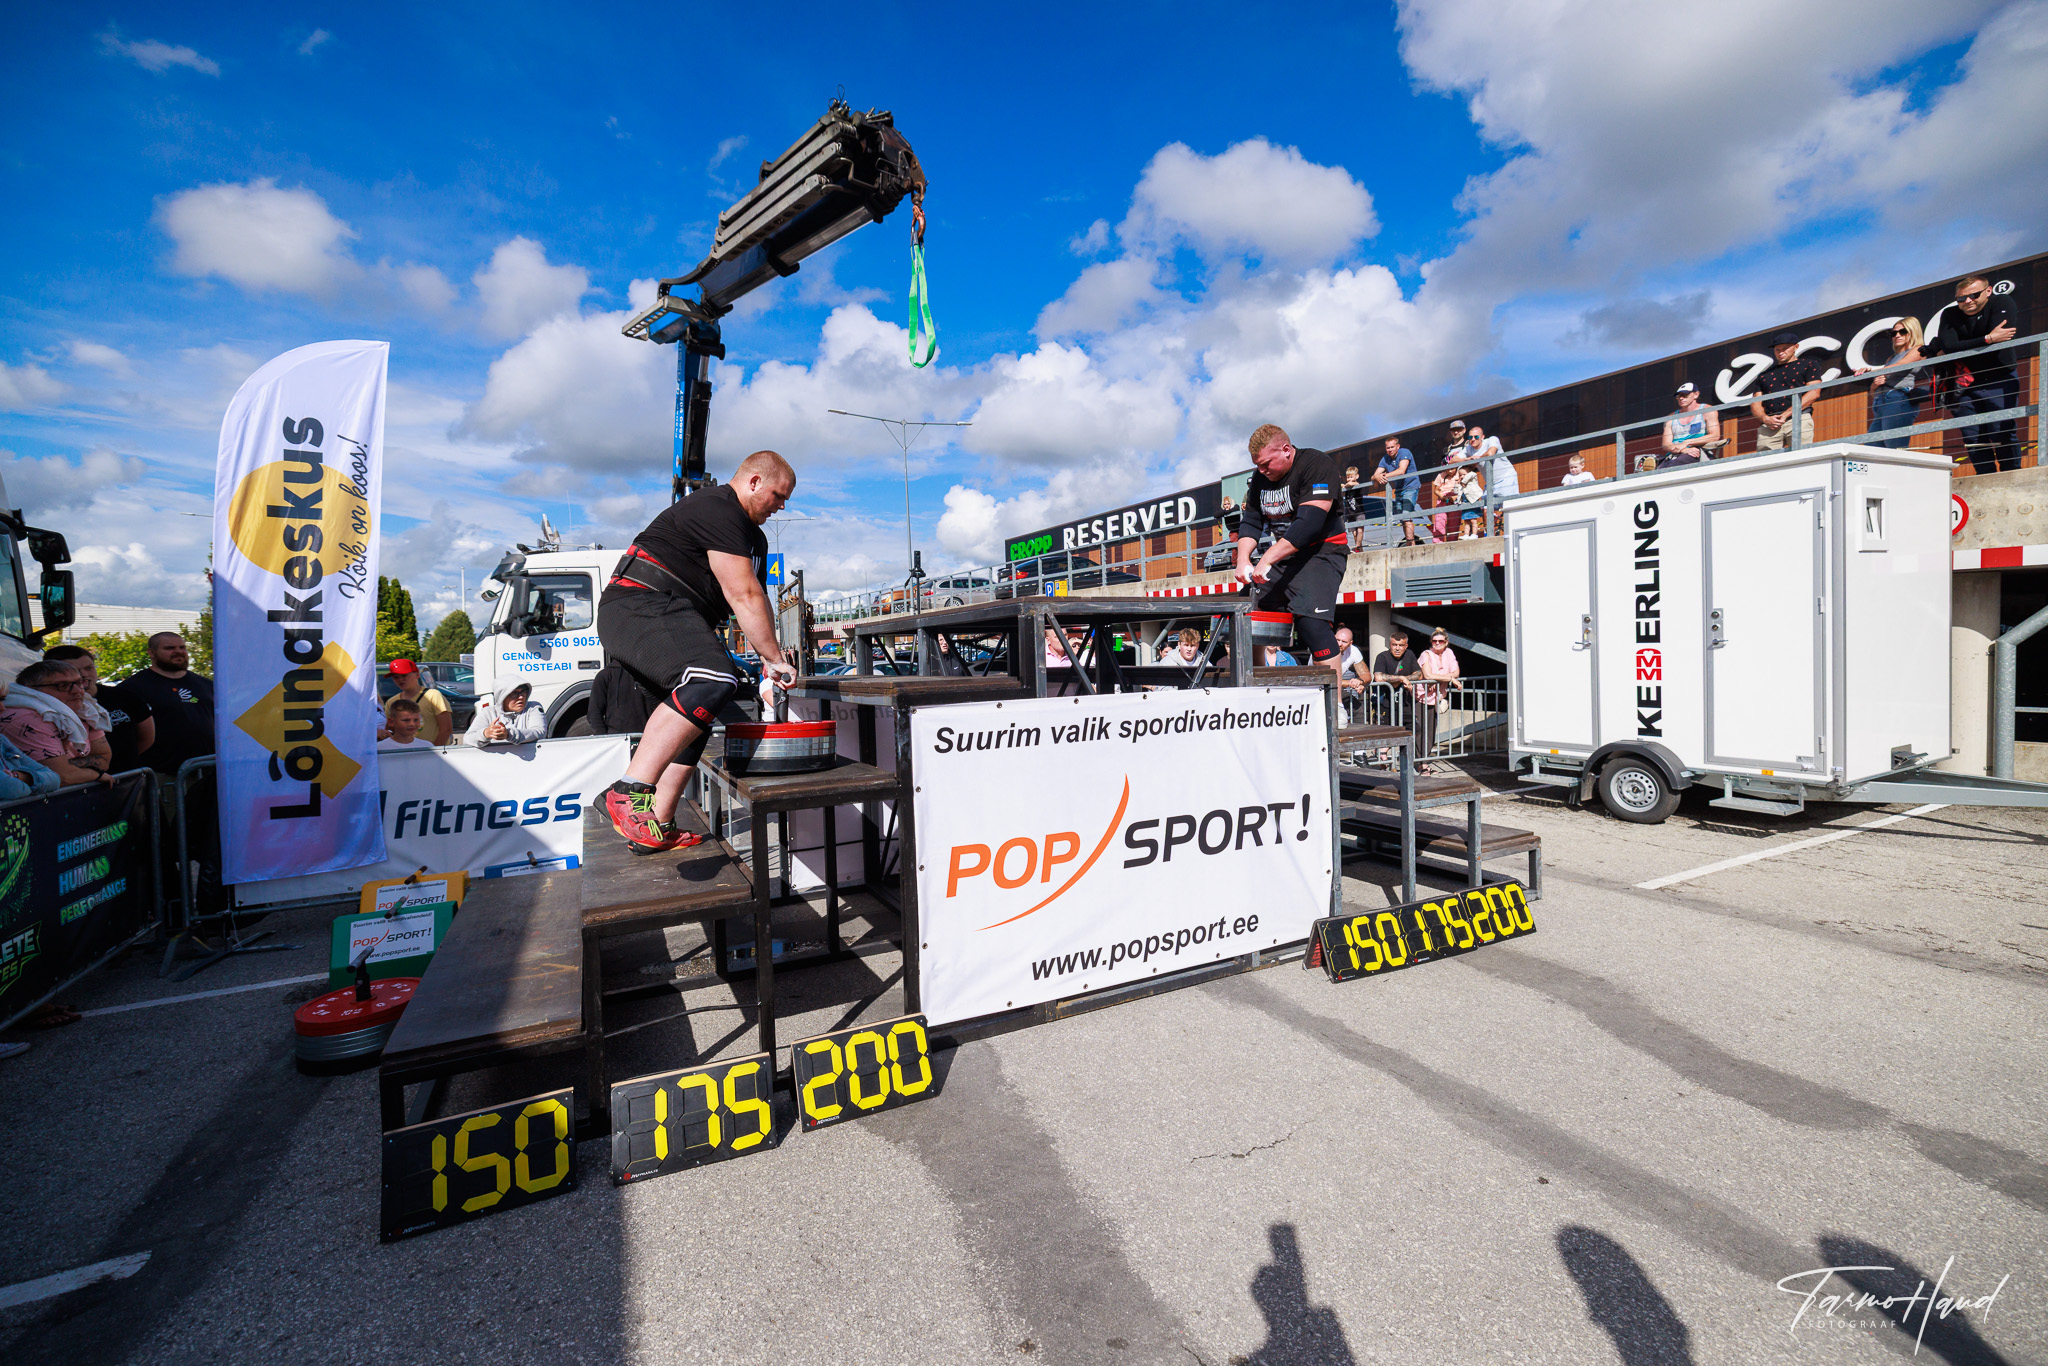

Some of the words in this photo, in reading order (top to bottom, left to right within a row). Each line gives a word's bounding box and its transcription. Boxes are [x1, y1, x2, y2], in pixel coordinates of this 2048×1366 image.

[337, 434, 369, 501] koos!
[353, 506, 371, 534] on
[1063, 496, 1197, 550] RESERVED
[338, 542, 368, 599] Kõik
[769, 561, 781, 577] 4
[1010, 534, 1053, 561] CROPP
[267, 416, 325, 820] Lõunakeskus
[539, 637, 569, 648] 5560
[502, 651, 541, 661] GENNO
[934, 723, 1040, 754] Suurim
[1051, 716, 1111, 744] valik
[1119, 703, 1310, 744] spordivahendeid!
[394, 792, 582, 840] fitness
[57, 820, 128, 862] ENGINEERING
[946, 831, 1081, 898] POP
[1123, 793, 1311, 869] SPORT!
[58, 856, 110, 896] HUMAN
[378, 900, 398, 910] PO
[406, 894, 445, 907] SPORT!
[353, 936, 379, 948] POP
[387, 927, 432, 943] SPORT!
[1031, 913, 1259, 981] www.popsport.ee
[1343, 912, 1407, 971] 150
[1414, 897, 1474, 952] 175
[1466, 883, 1533, 941] 200
[368, 946, 421, 959] ww.popsport.ee
[801, 1020, 933, 1120] 200
[652, 1060, 772, 1161] 175
[430, 1096, 570, 1214] 150
